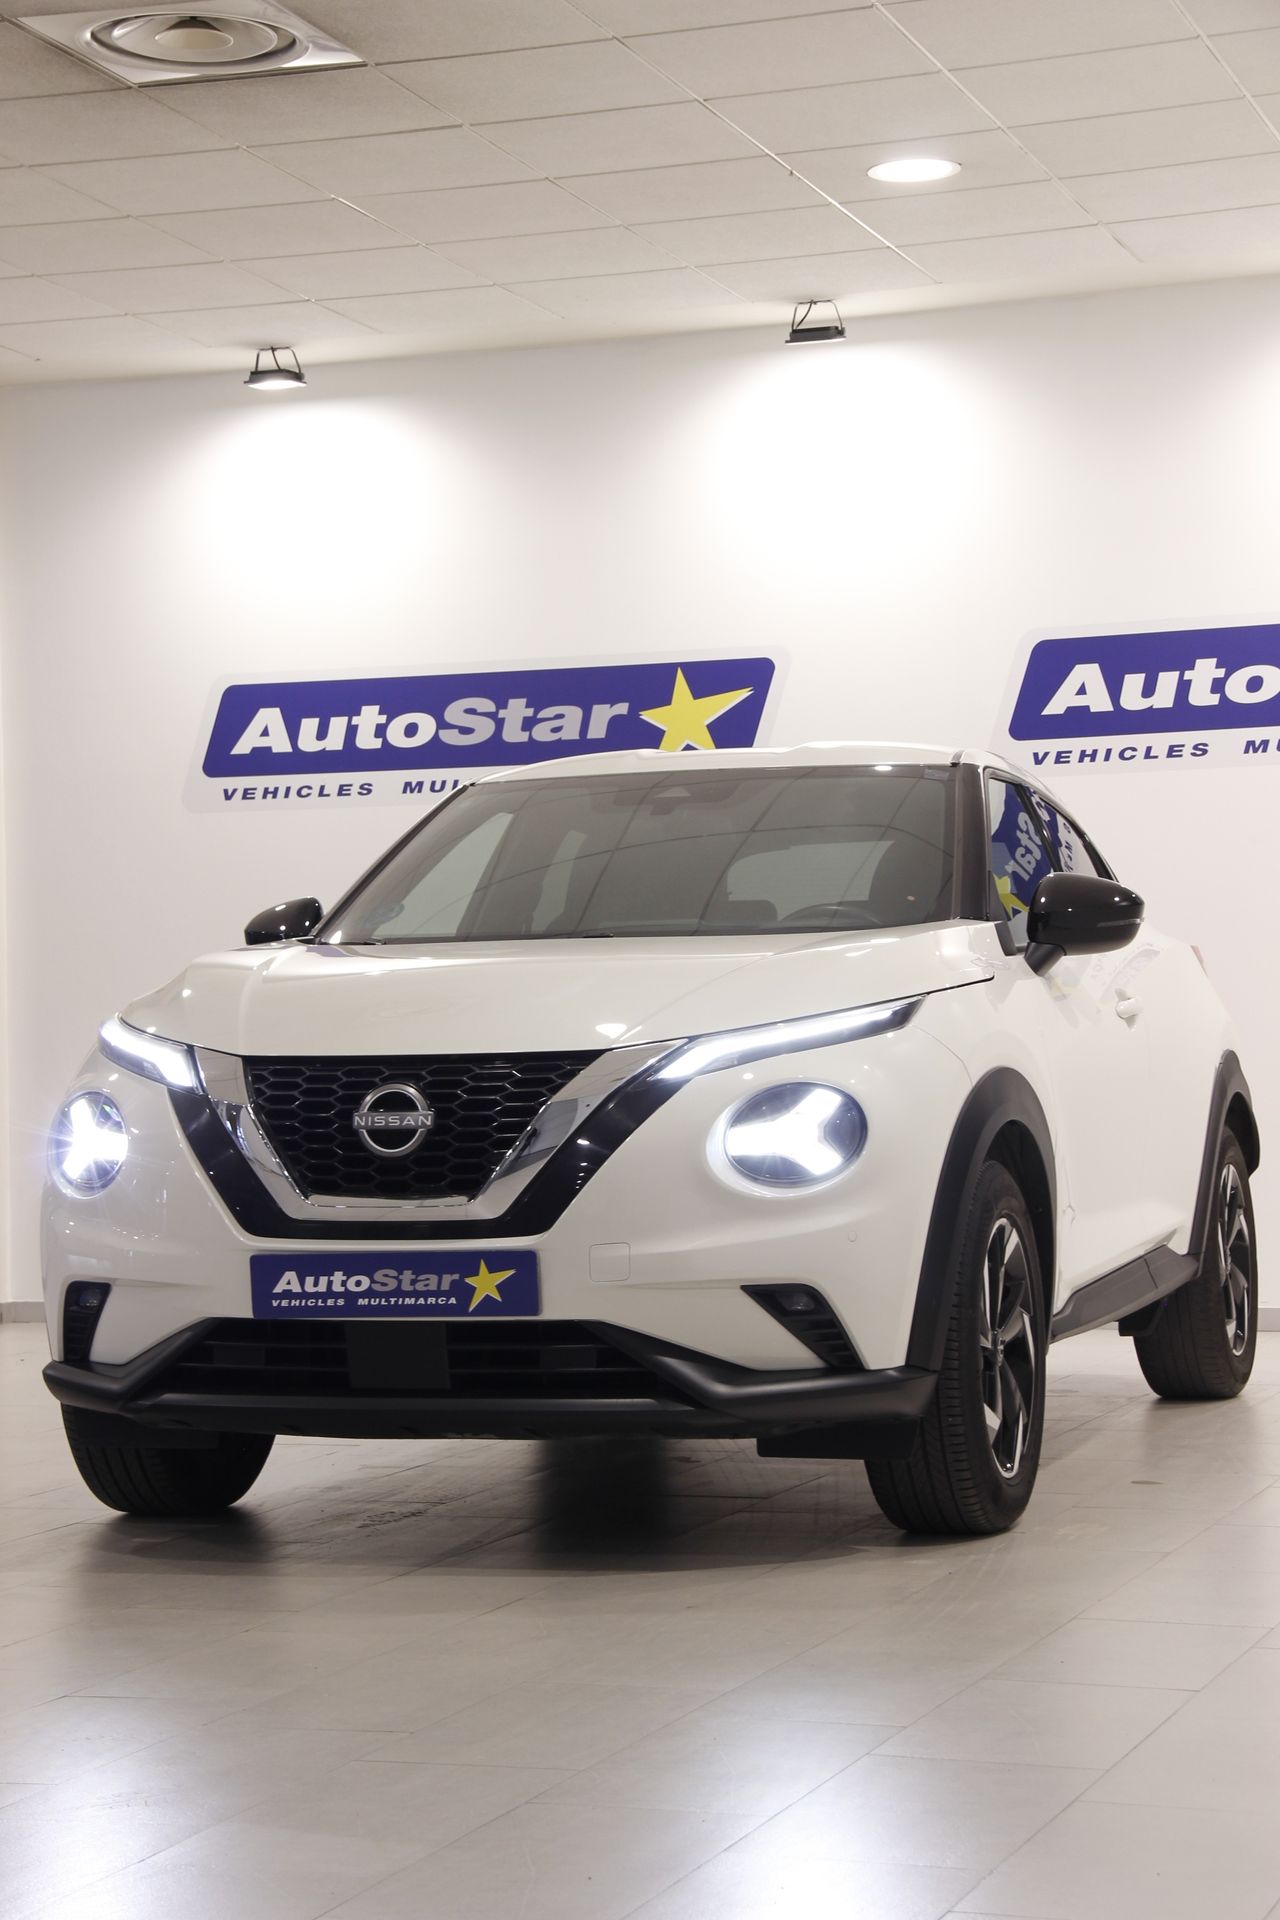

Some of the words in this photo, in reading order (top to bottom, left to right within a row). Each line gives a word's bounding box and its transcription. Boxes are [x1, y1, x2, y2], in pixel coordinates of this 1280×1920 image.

[230, 697, 630, 755] AutoStar
[1032, 742, 1209, 766] VEHICLES
[1243, 738, 1280, 755] M
[222, 782, 374, 801] VEHICLES
[354, 1115, 432, 1126] NISSAN
[272, 1269, 460, 1293] AutoStar
[272, 1299, 345, 1307] VEHICLES
[357, 1297, 457, 1306] MULTIMARCA
